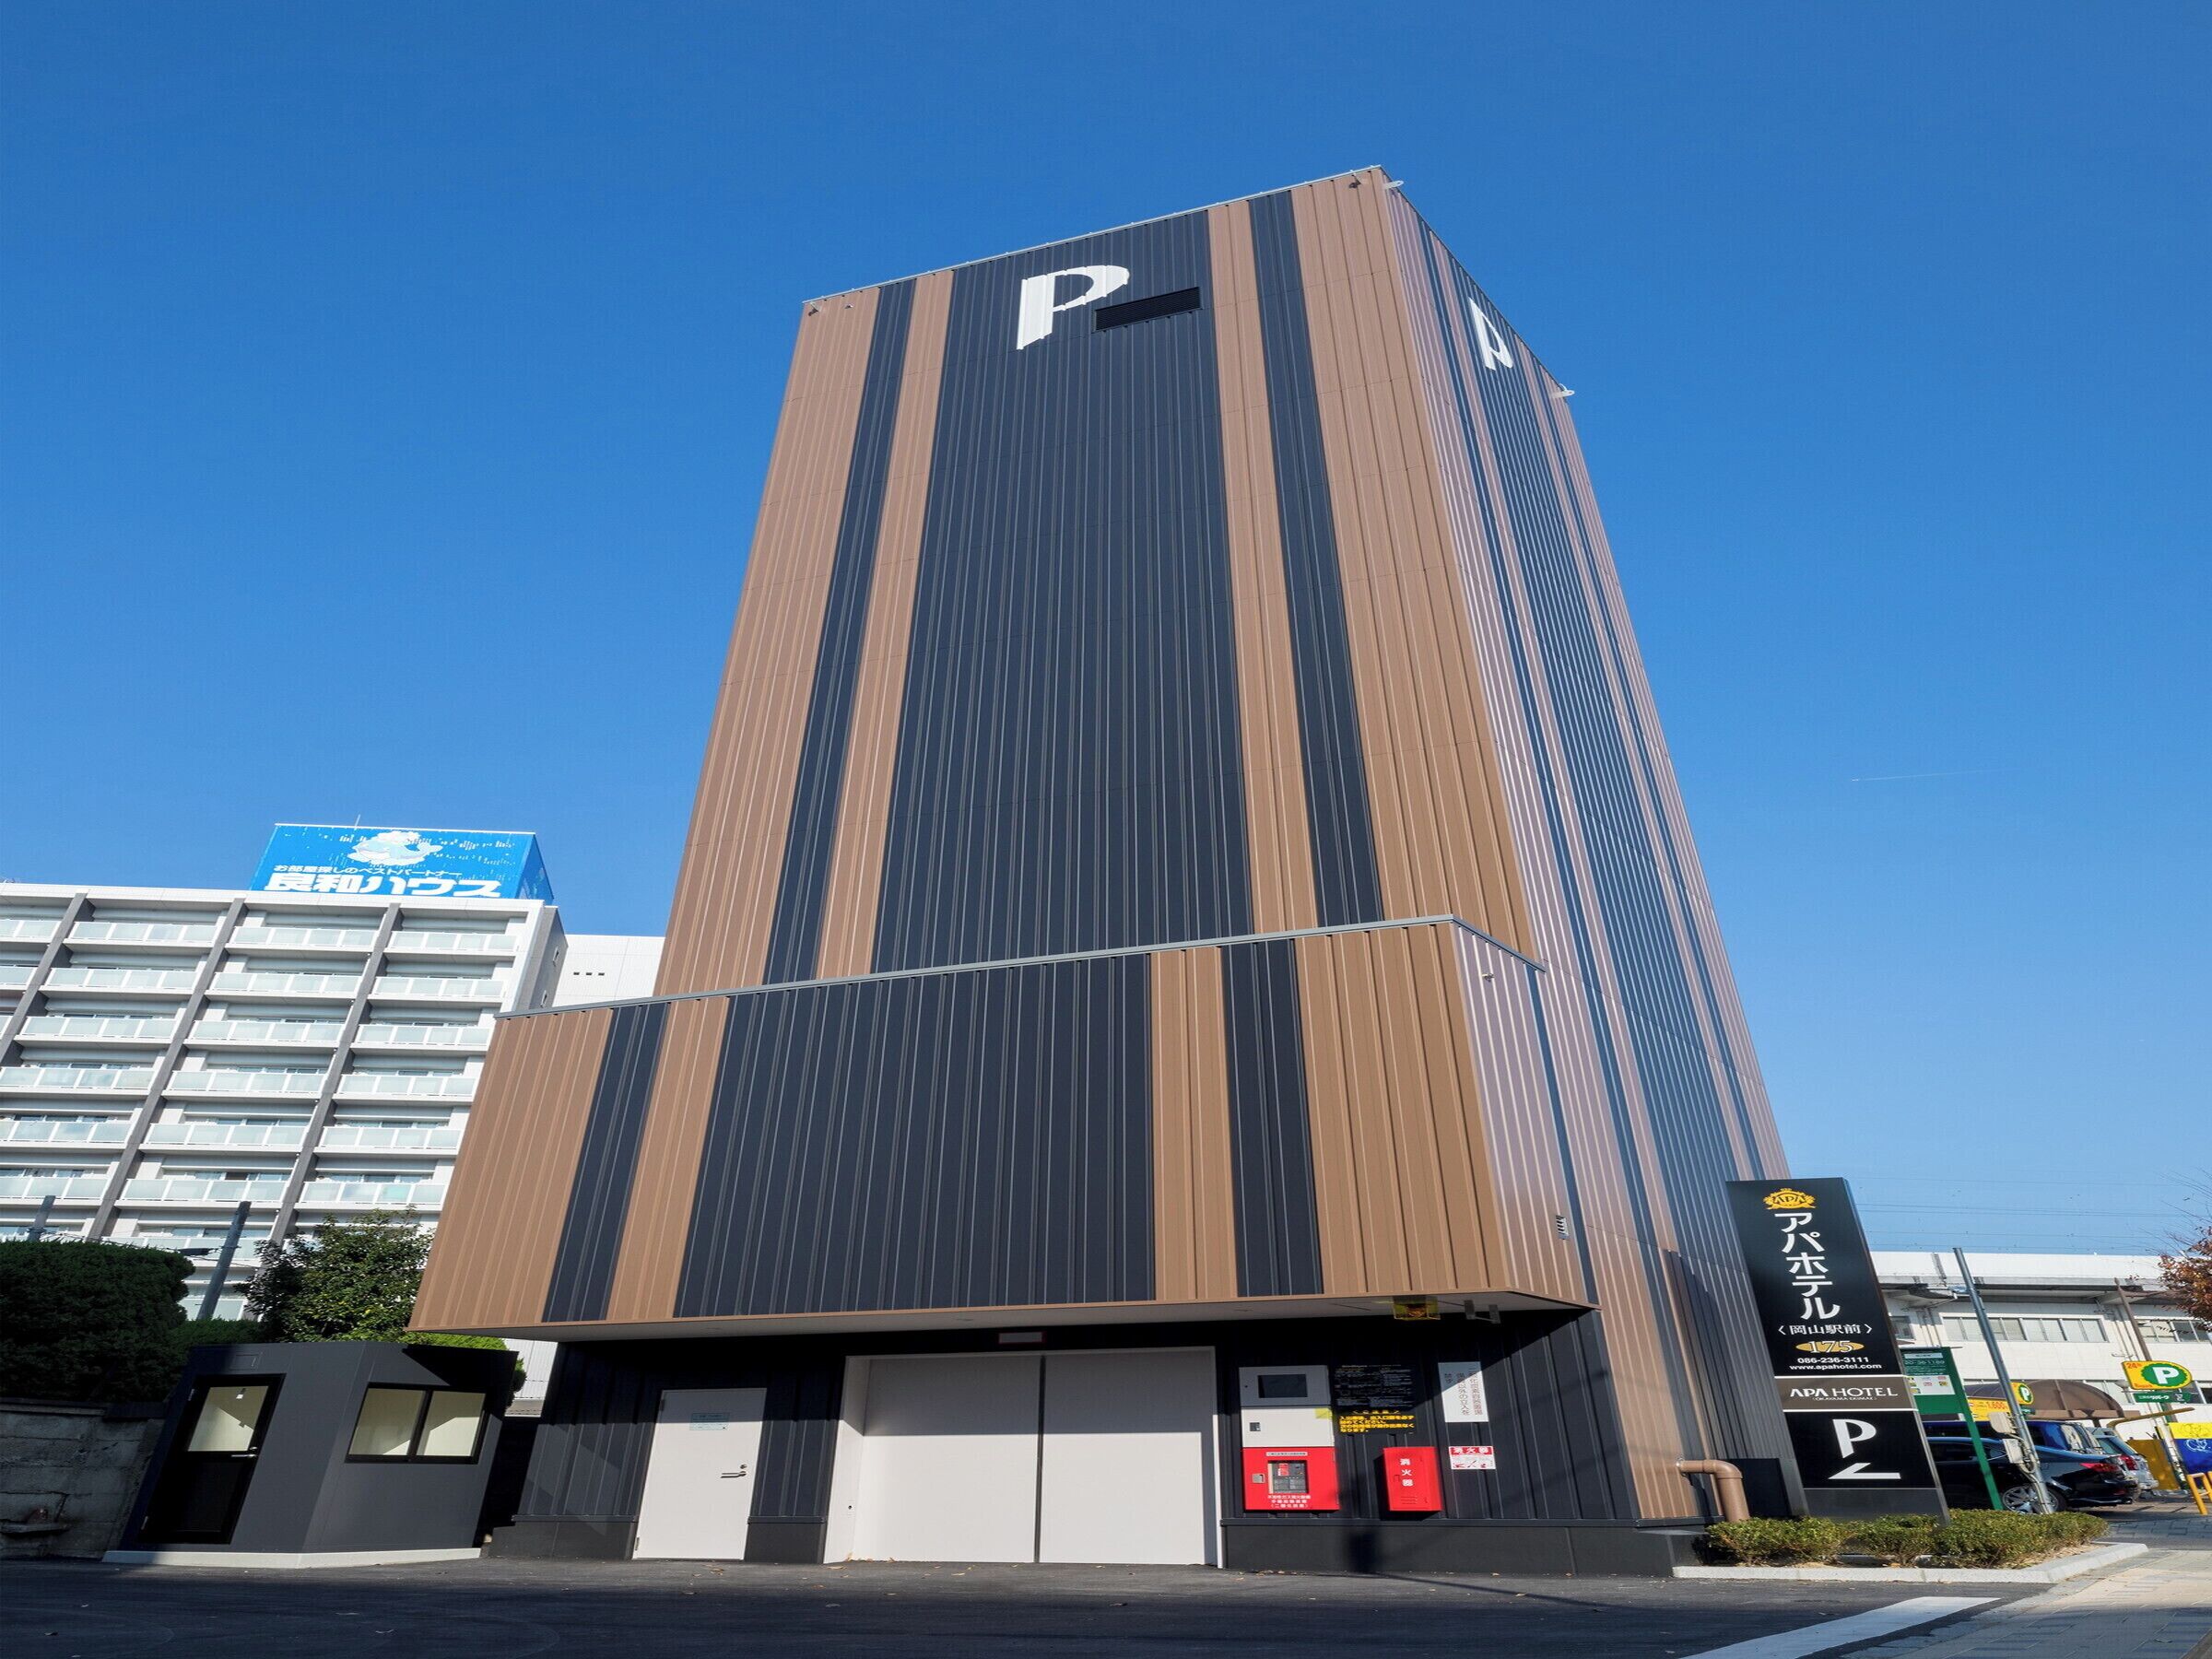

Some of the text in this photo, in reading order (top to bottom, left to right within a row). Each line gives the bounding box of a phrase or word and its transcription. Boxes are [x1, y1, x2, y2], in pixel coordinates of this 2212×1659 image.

[1016, 265, 1131, 350] P
[1467, 296, 1514, 371] P
[264, 871, 502, 898] 良和ハウス
[1774, 1212, 1841, 1320] アパホテル
[1807, 1340, 1853, 1354] 175
[2152, 1366, 2180, 1384] P
[1790, 1387, 1899, 1397] APA HOTEL
[2022, 1386, 2030, 1403] P
[1832, 1418, 1877, 1459] P
[1399, 1458, 1414, 1487] 消火器
